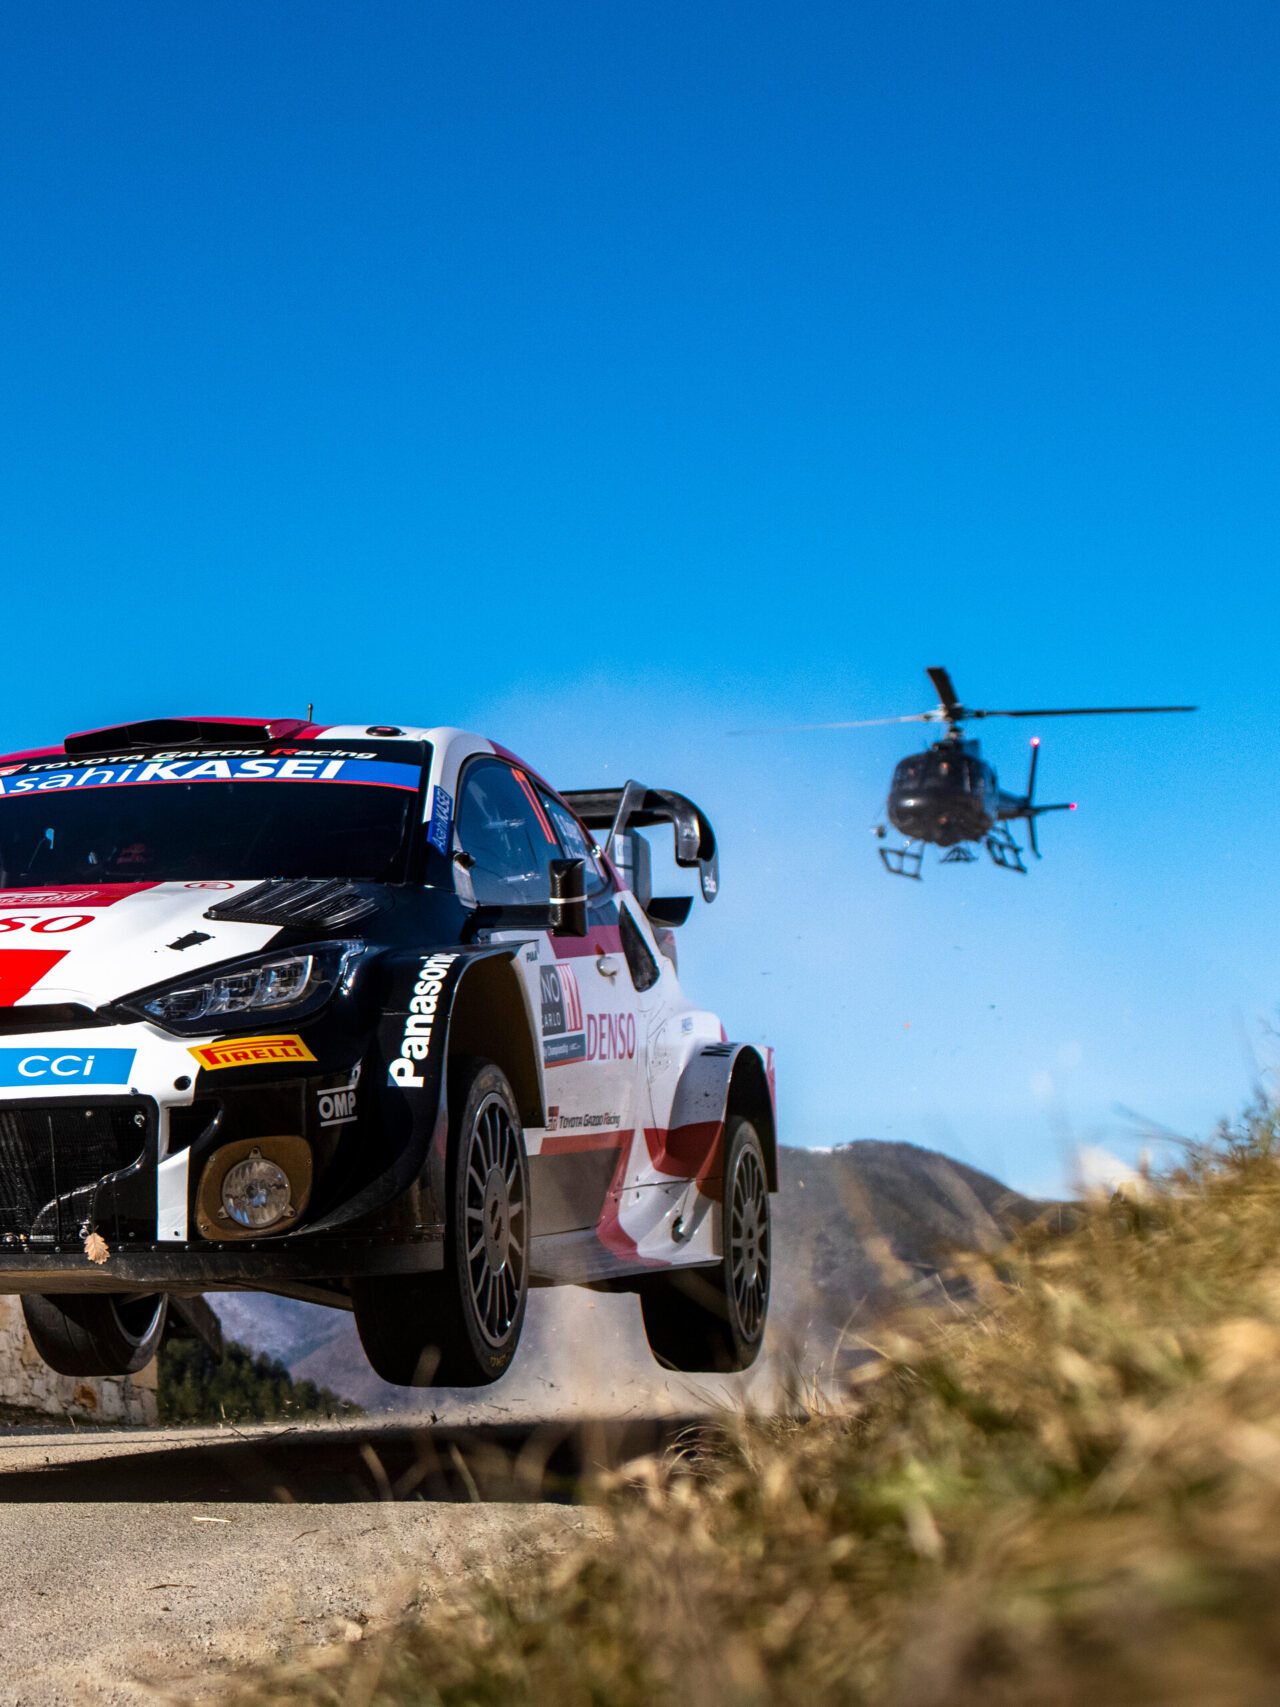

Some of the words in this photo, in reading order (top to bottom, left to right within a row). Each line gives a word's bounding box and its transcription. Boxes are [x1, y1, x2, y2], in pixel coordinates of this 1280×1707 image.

[29, 754, 145, 772] TOYOTA
[152, 749, 265, 761] GAZOO
[270, 748, 378, 759] Racing
[541, 1011, 562, 1028] ARLO
[586, 1012, 636, 1061] DENSO
[198, 1039, 305, 1066] PIRELLI
[318, 1091, 357, 1120] OMP
[560, 1115, 583, 1129] TOYOTA
